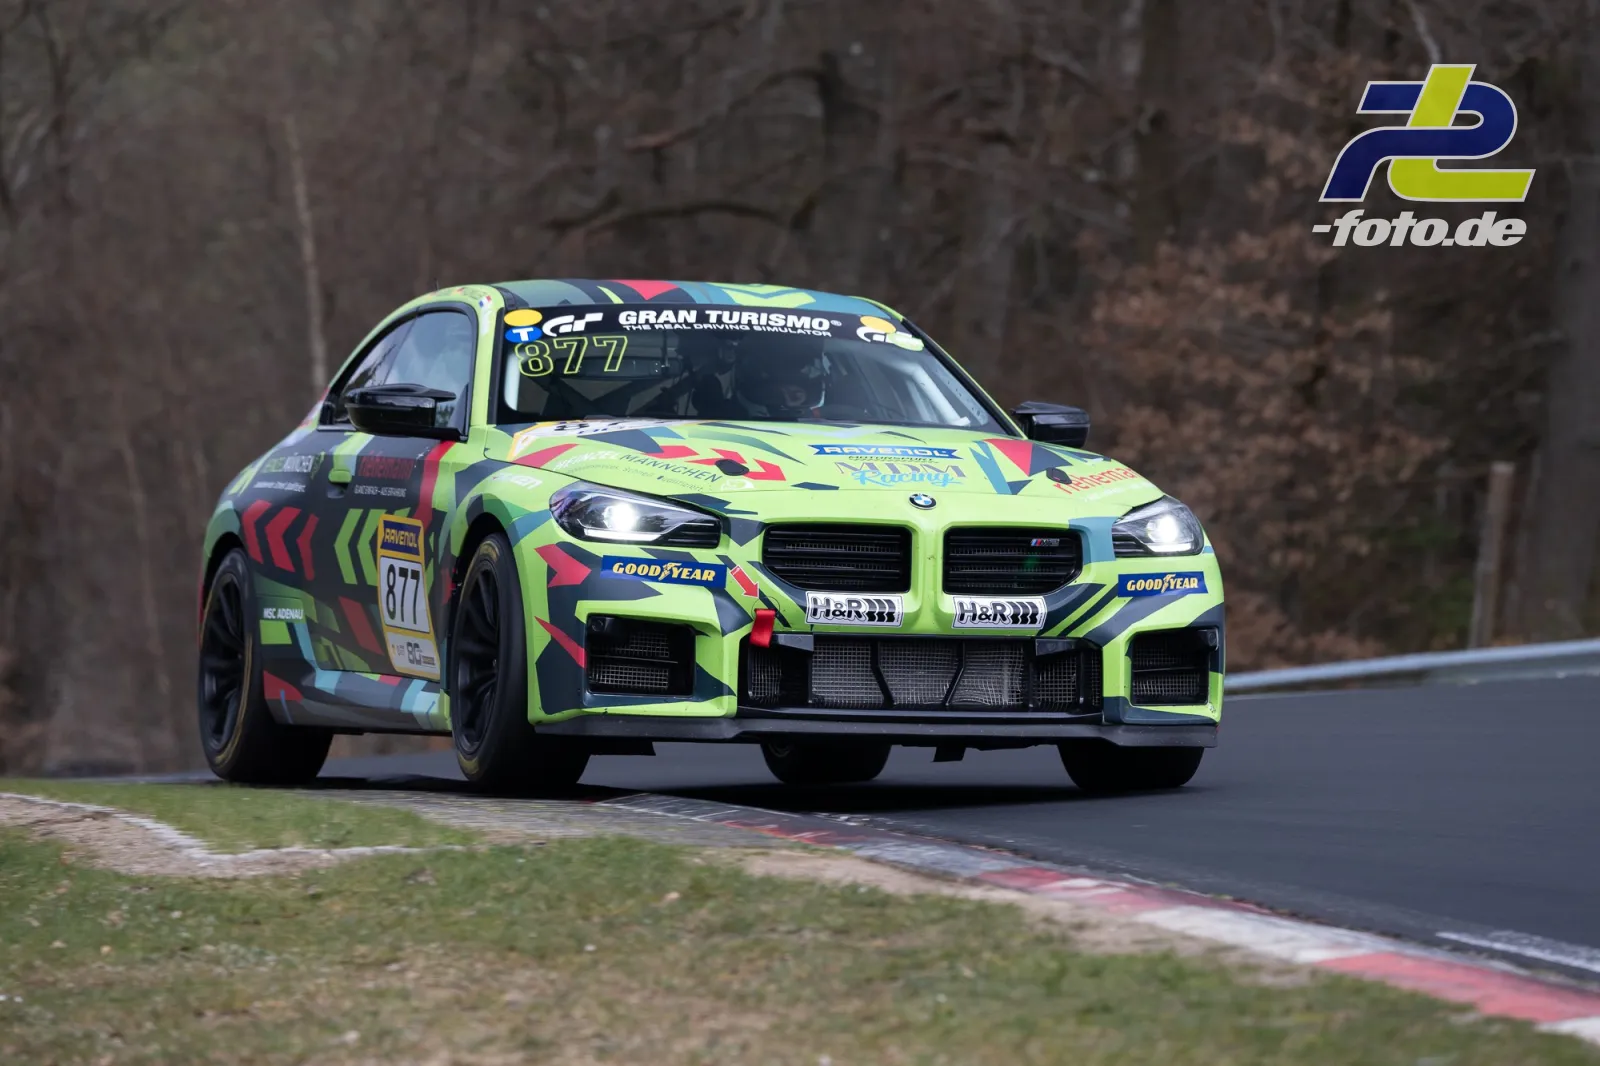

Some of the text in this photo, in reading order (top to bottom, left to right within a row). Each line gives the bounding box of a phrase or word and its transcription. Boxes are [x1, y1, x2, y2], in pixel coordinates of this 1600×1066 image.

[618, 310, 698, 325] GRAN
[512, 327, 534, 341] T
[692, 323, 751, 331] DRIVING
[753, 325, 832, 337] SIMULATOR
[514, 335, 629, 377] 877
[823, 446, 949, 457] RAVENOL
[851, 469, 964, 488] Racing
[384, 528, 418, 548] RAVENOL
[386, 563, 421, 625] 877
[263, 608, 303, 620] MSC ADENAU
[809, 596, 864, 623] H&R
[956, 600, 1010, 624] H&R
